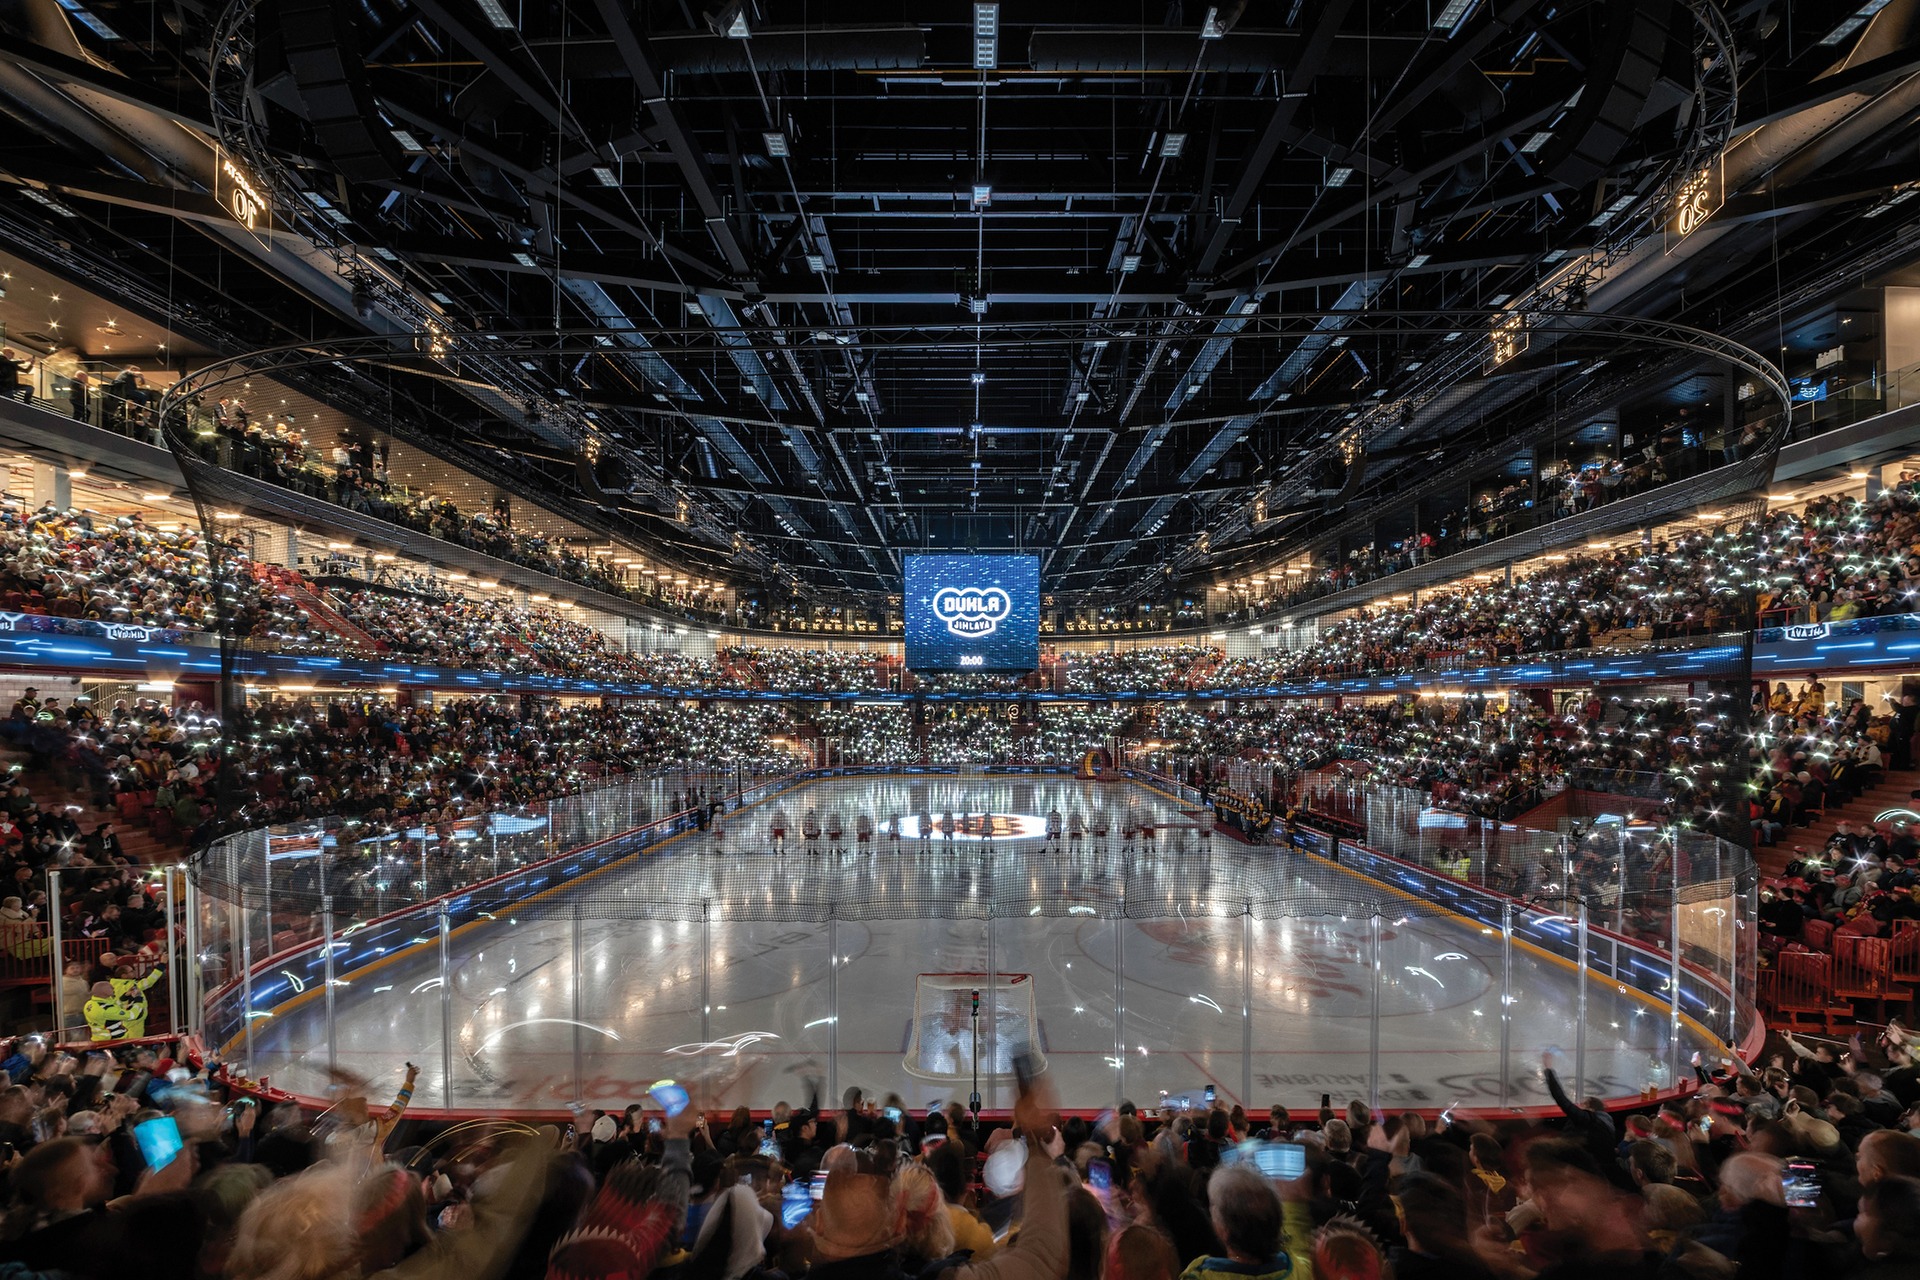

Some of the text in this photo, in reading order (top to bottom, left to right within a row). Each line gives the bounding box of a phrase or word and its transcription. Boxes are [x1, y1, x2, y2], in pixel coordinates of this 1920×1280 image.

[944, 597, 999, 612] DUKLA
[953, 620, 990, 631] JIHLAVA
[960, 656, 983, 665] 20:00
